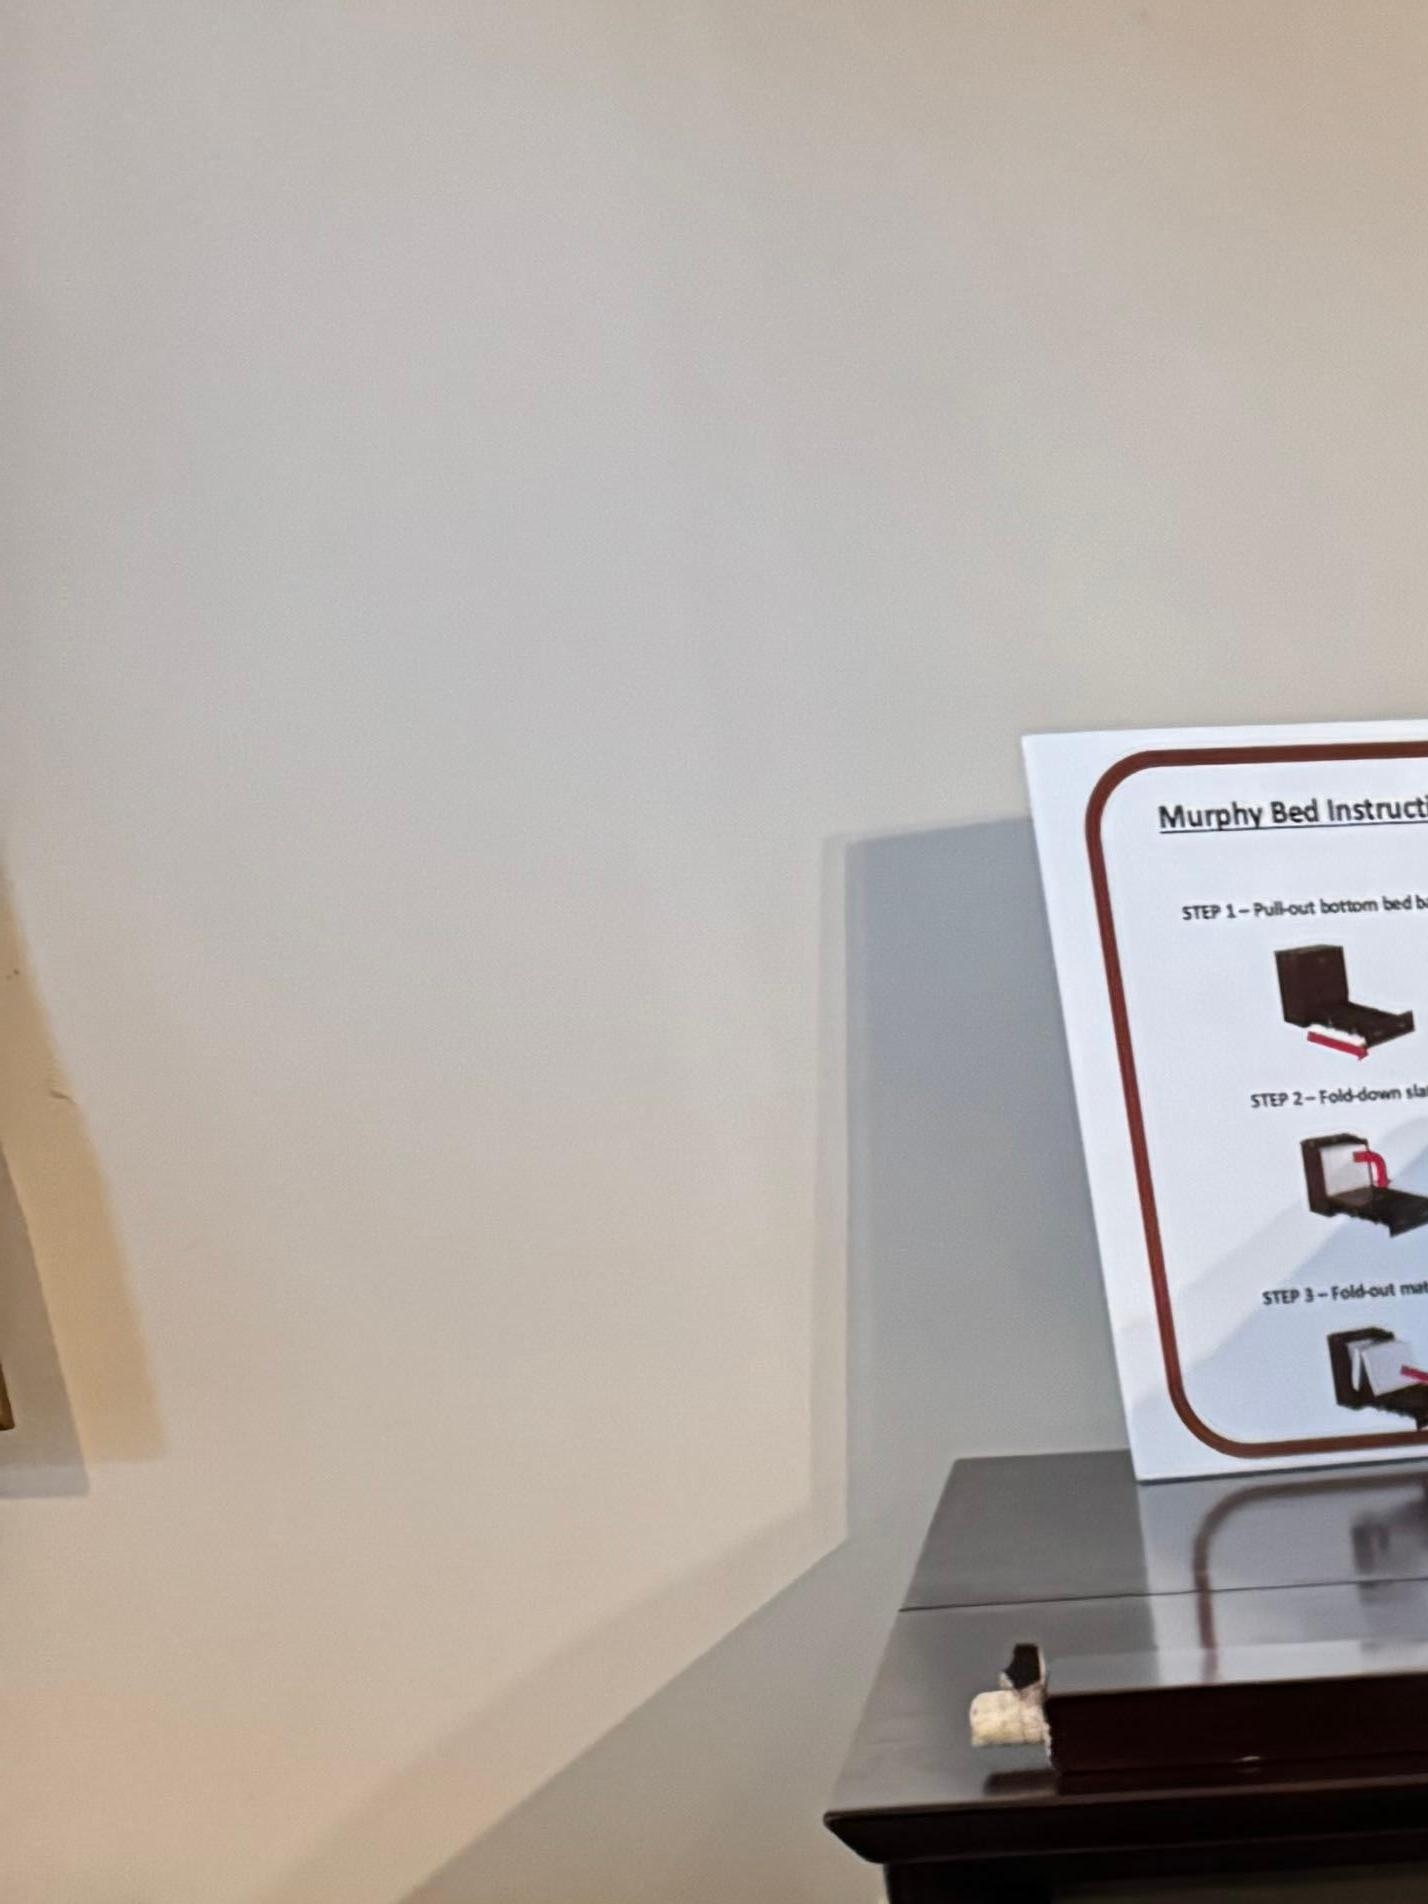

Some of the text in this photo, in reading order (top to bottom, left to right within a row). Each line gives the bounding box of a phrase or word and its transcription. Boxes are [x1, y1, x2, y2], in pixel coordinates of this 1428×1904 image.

[1158, 801, 1263, 830] Murphy
[1271, 798, 1319, 824] Bed
[1182, 904, 1221, 920] STEP
[1226, 903, 1236, 918] 1
[1254, 900, 1315, 917] Pull-out
[1320, 898, 1378, 914] bottom
[1382, 895, 1412, 911] bed
[1251, 1093, 1289, 1108] STEP
[1293, 1091, 1303, 1107] 2
[1319, 1086, 1402, 1104] Fold-down
[1262, 1290, 1300, 1306] STEP
[1304, 1287, 1314, 1303] 3
[1331, 1283, 1394, 1301] Fold-out
